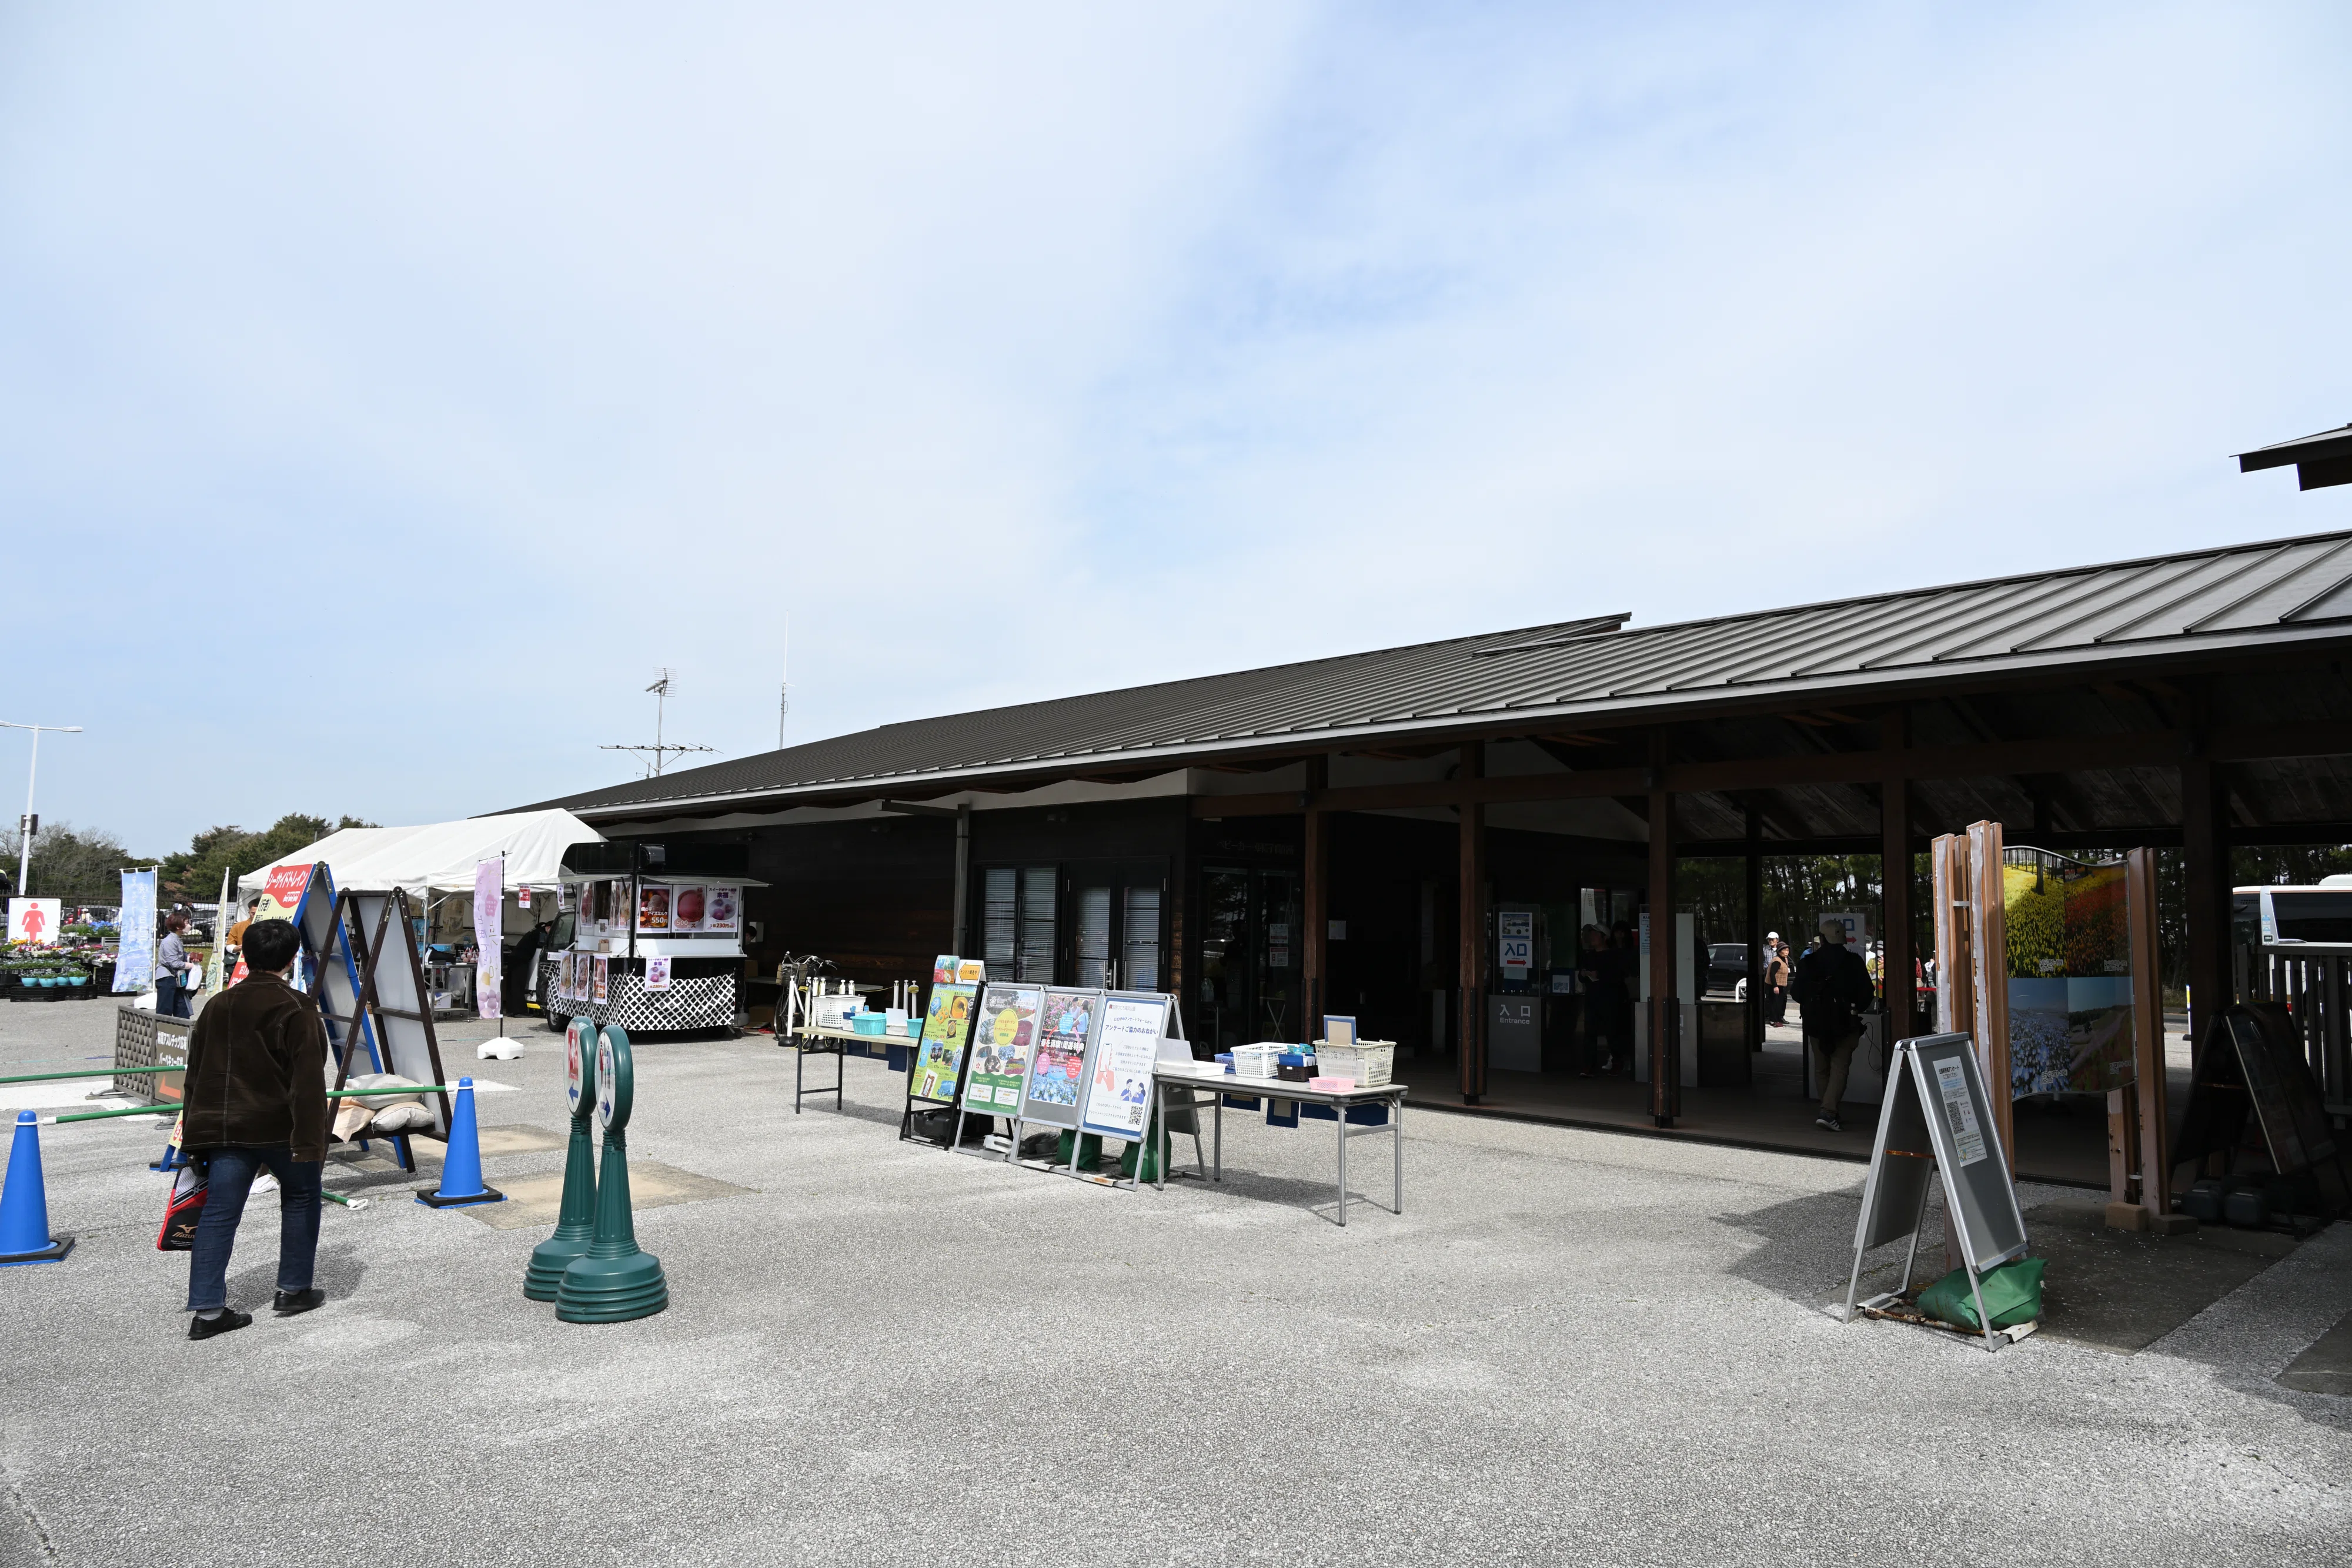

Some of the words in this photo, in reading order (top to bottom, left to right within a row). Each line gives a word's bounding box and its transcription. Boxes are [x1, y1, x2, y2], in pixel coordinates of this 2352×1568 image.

[266, 871, 308, 888] シーサイドトレイン
[1505, 943, 1526, 956] 入口
[1105, 1025, 1158, 1035] アンケートご協力のおねがい
